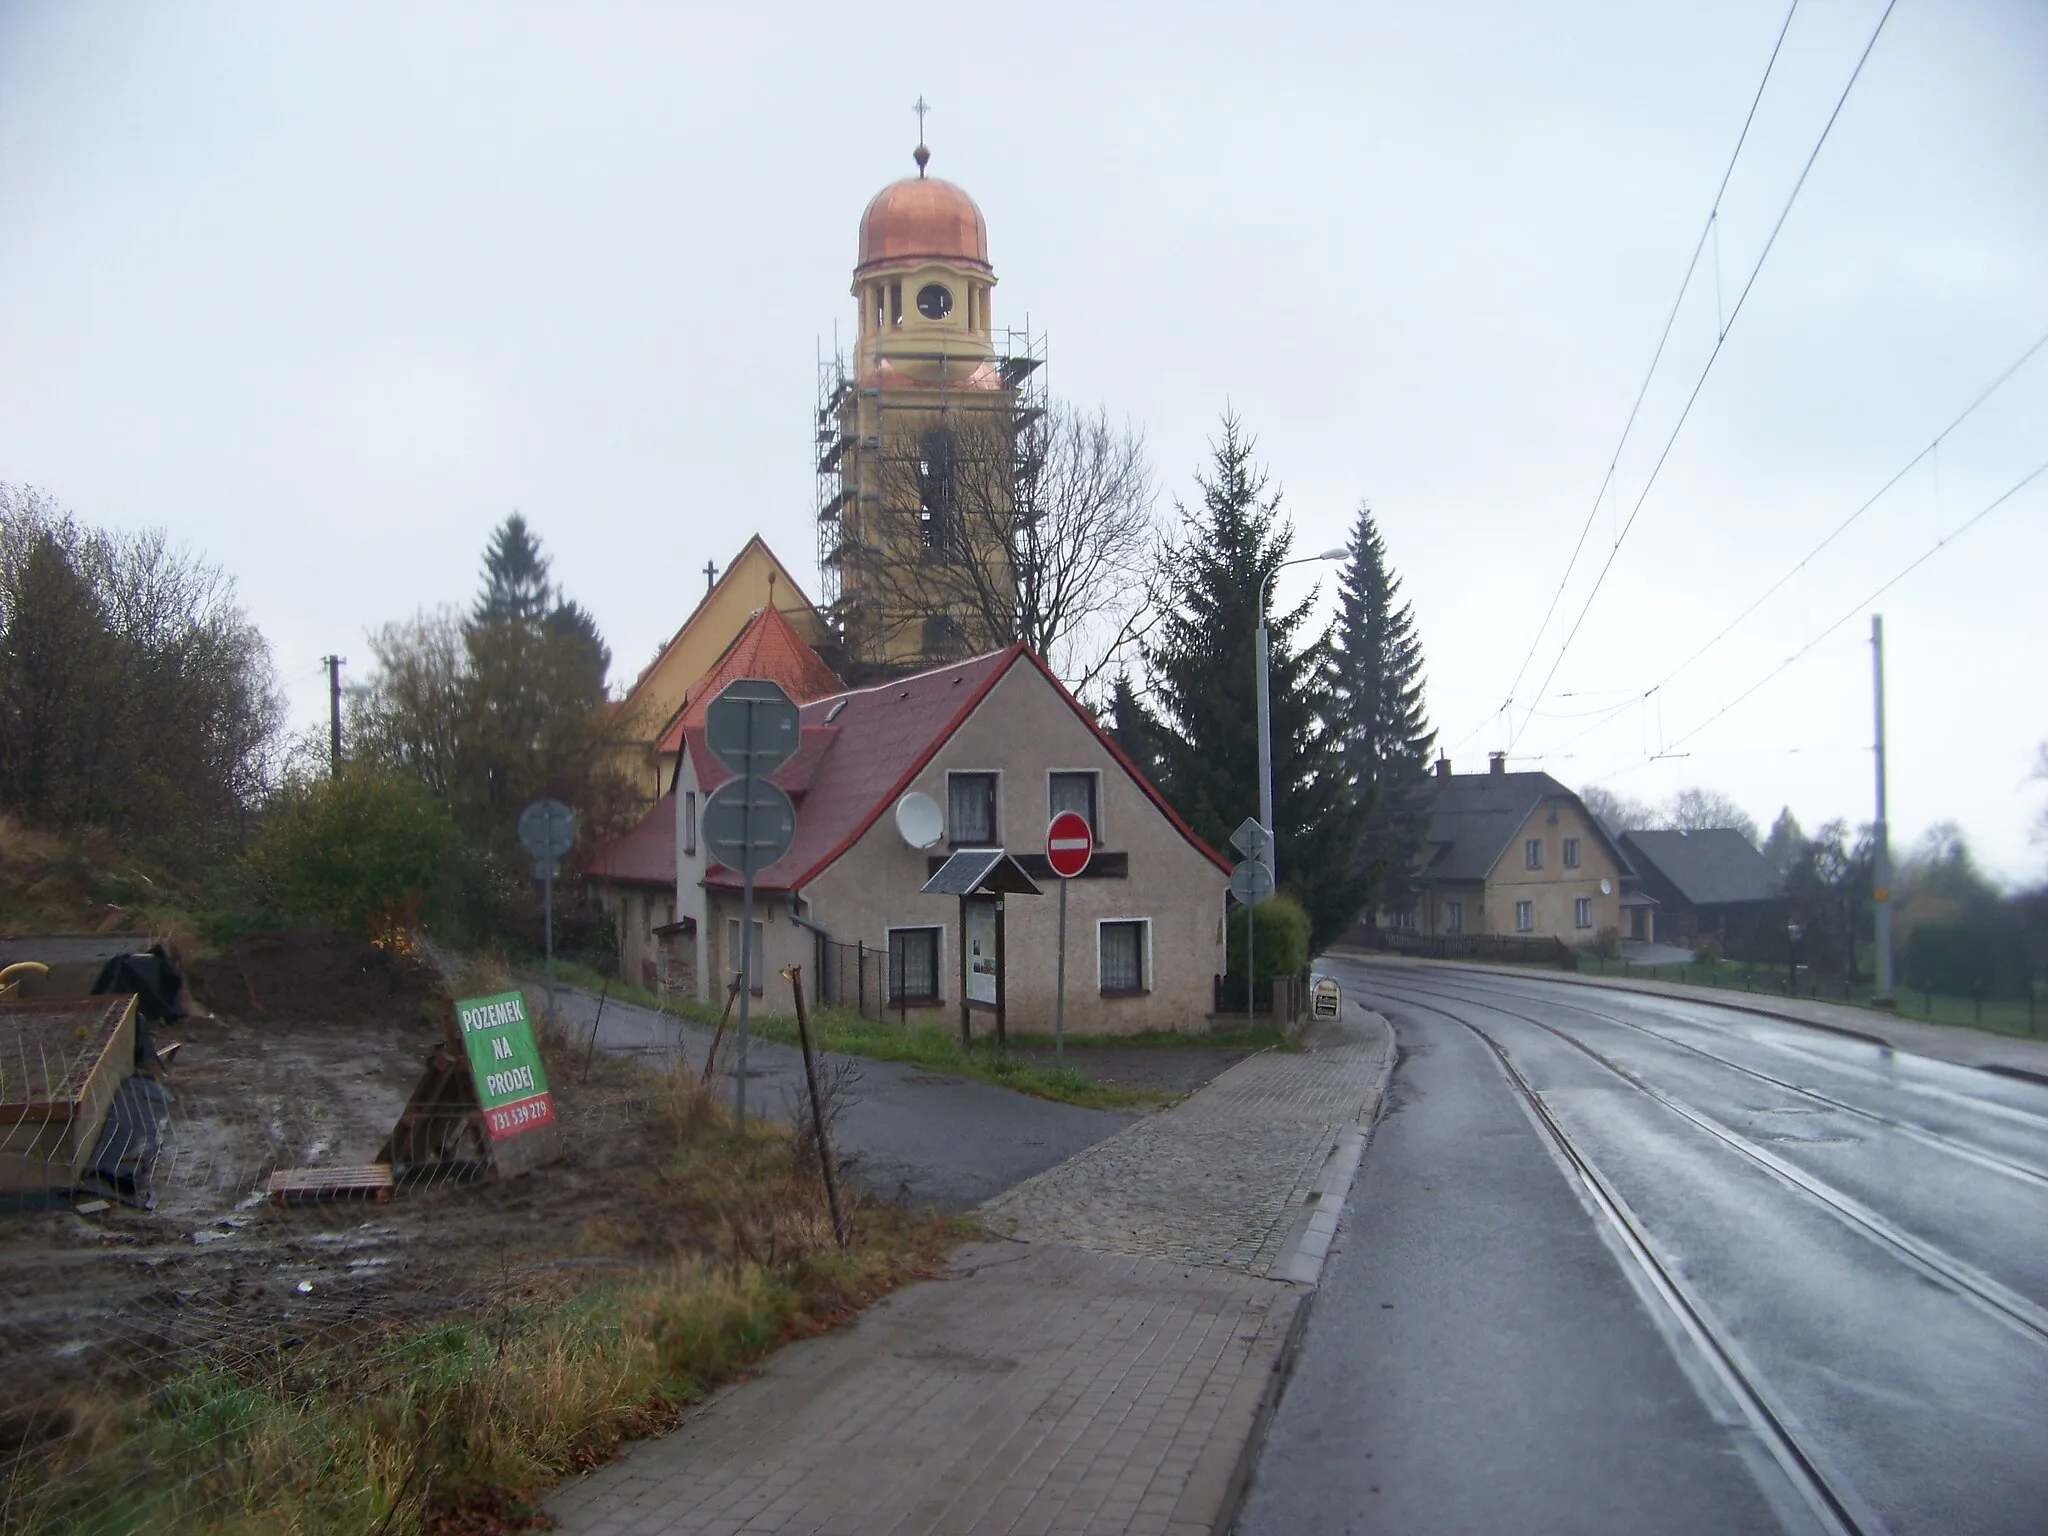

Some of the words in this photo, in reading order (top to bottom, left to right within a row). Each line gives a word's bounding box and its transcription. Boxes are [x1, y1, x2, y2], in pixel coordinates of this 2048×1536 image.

[462, 999, 524, 1033] POZEMEK
[492, 1036, 513, 1061] NA
[486, 1065, 535, 1097] PRODEJ
[492, 1111, 510, 1131] 731
[511, 1106, 529, 1126] 539
[530, 1100, 547, 1119] 279
